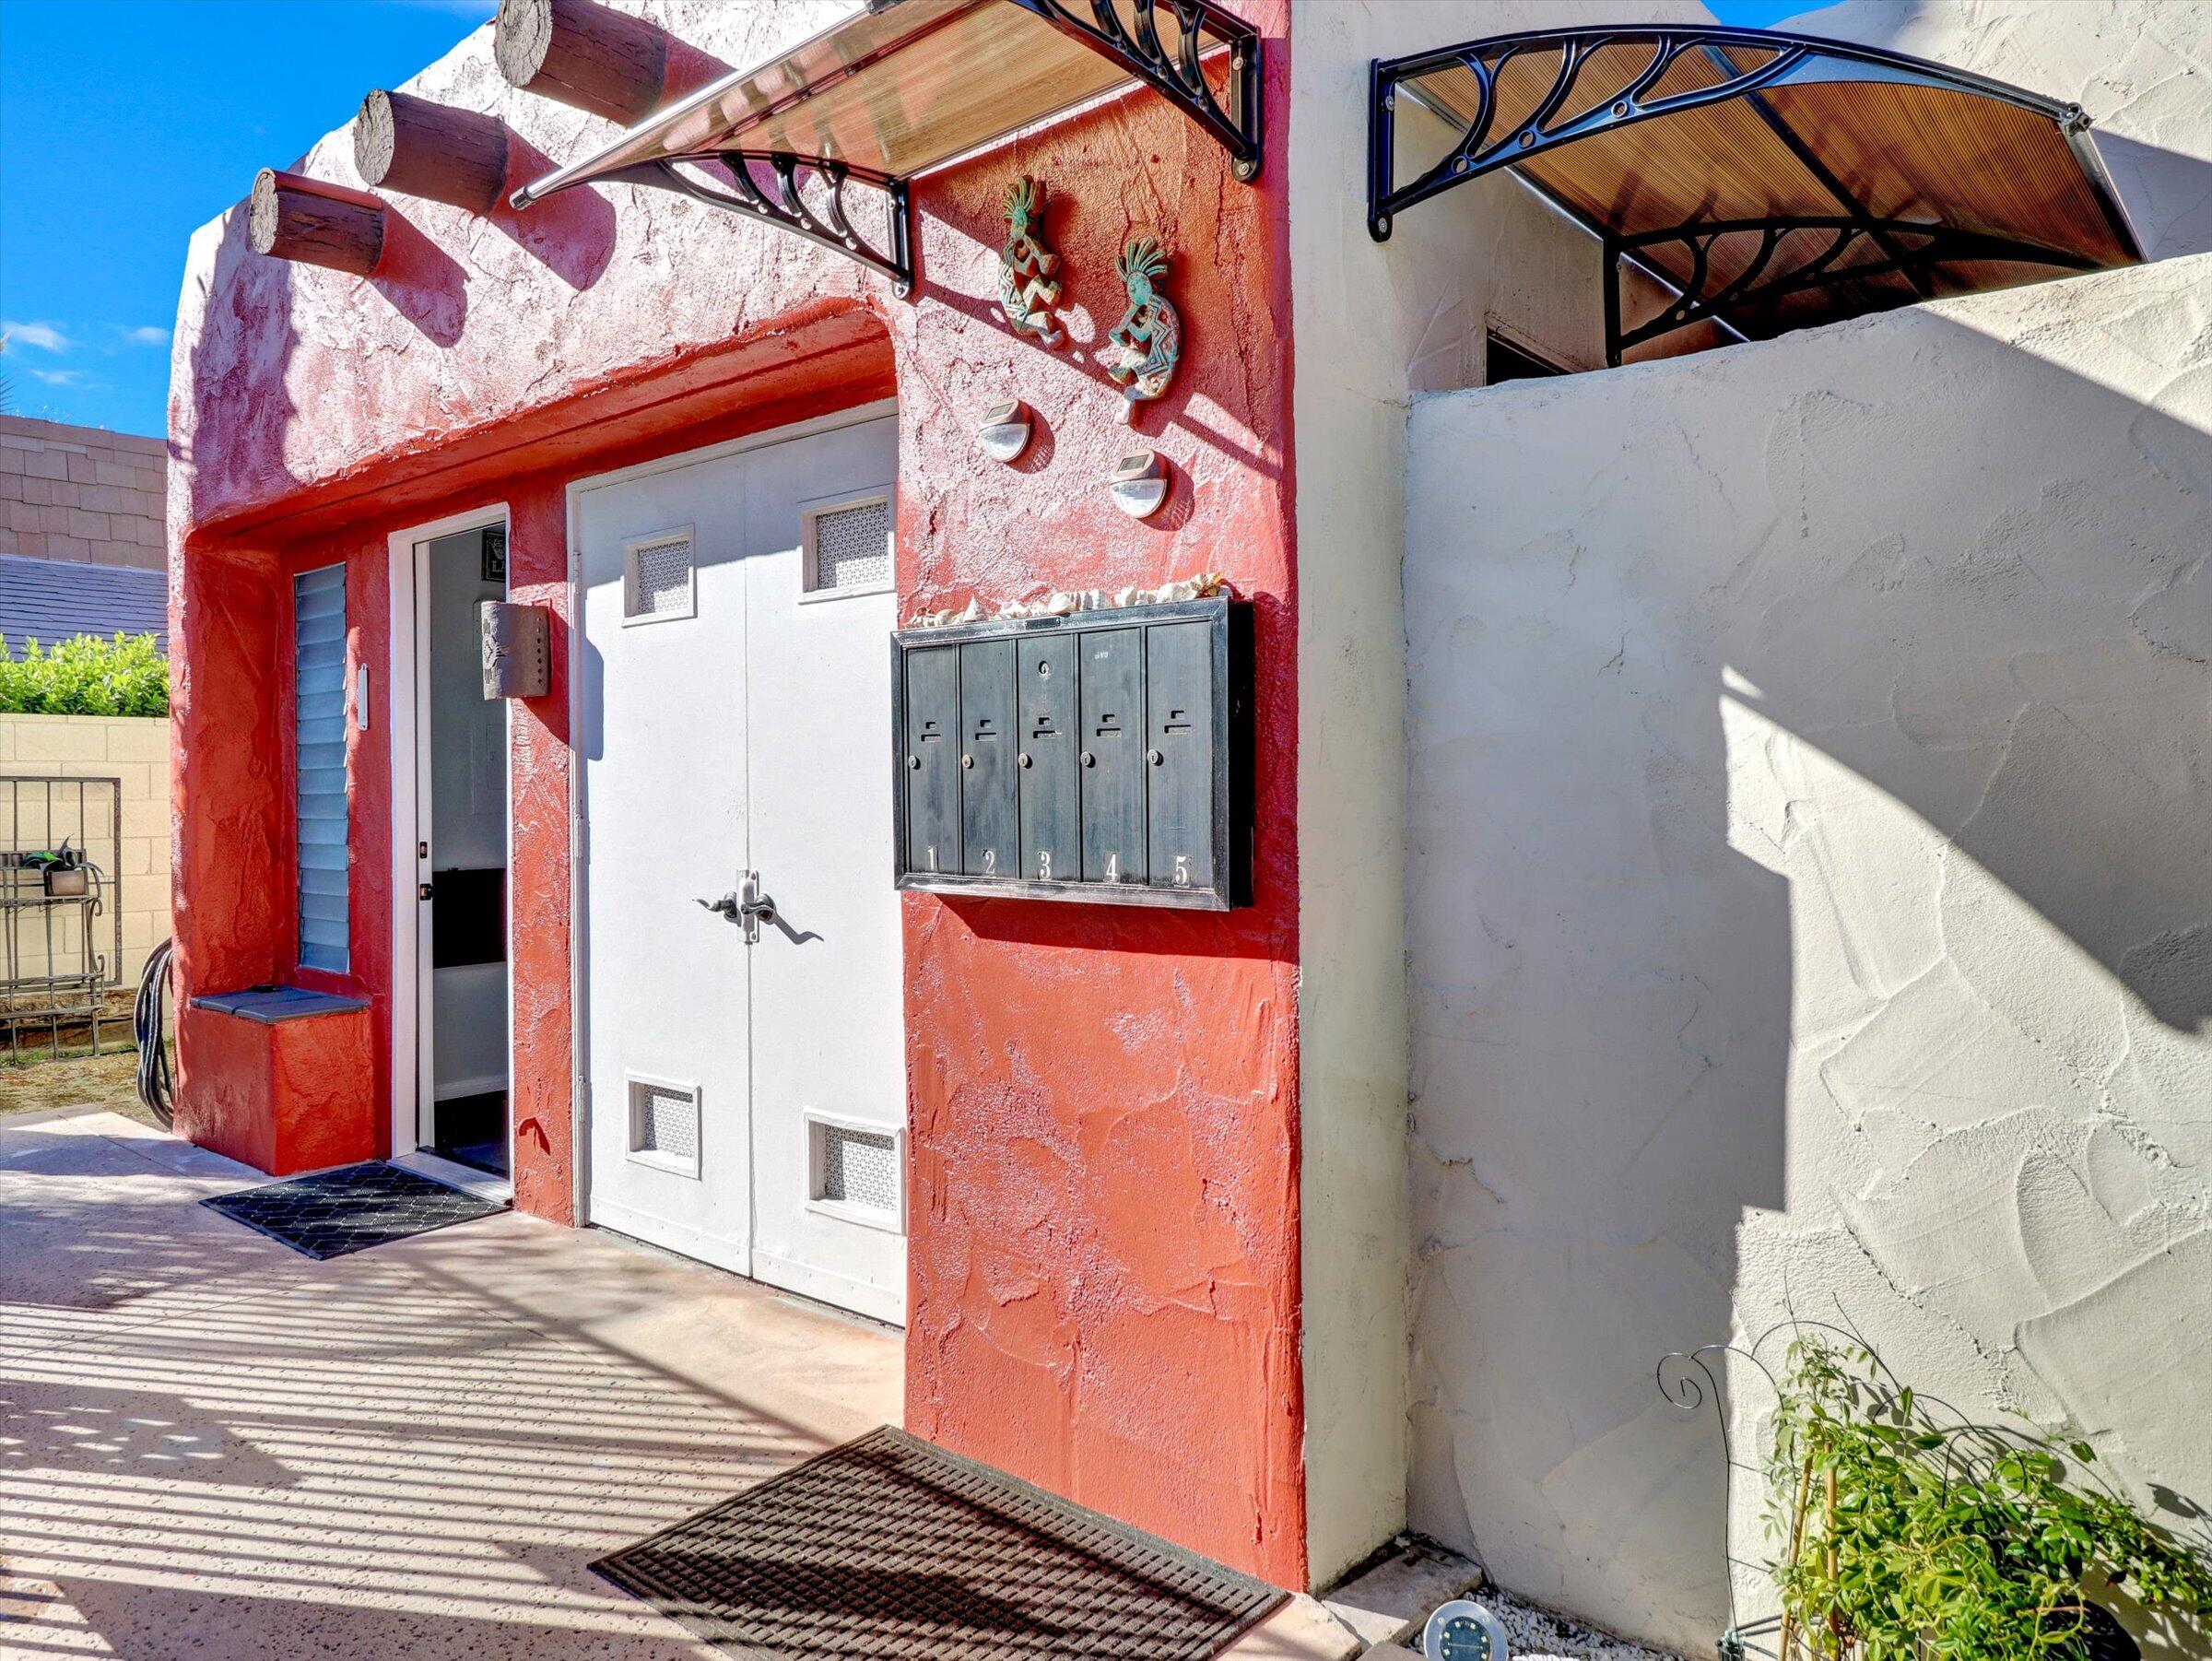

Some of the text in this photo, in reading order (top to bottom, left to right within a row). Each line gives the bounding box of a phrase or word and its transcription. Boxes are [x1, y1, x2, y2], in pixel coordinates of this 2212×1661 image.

[927, 846, 1188, 885] 1 2 3 4 5
